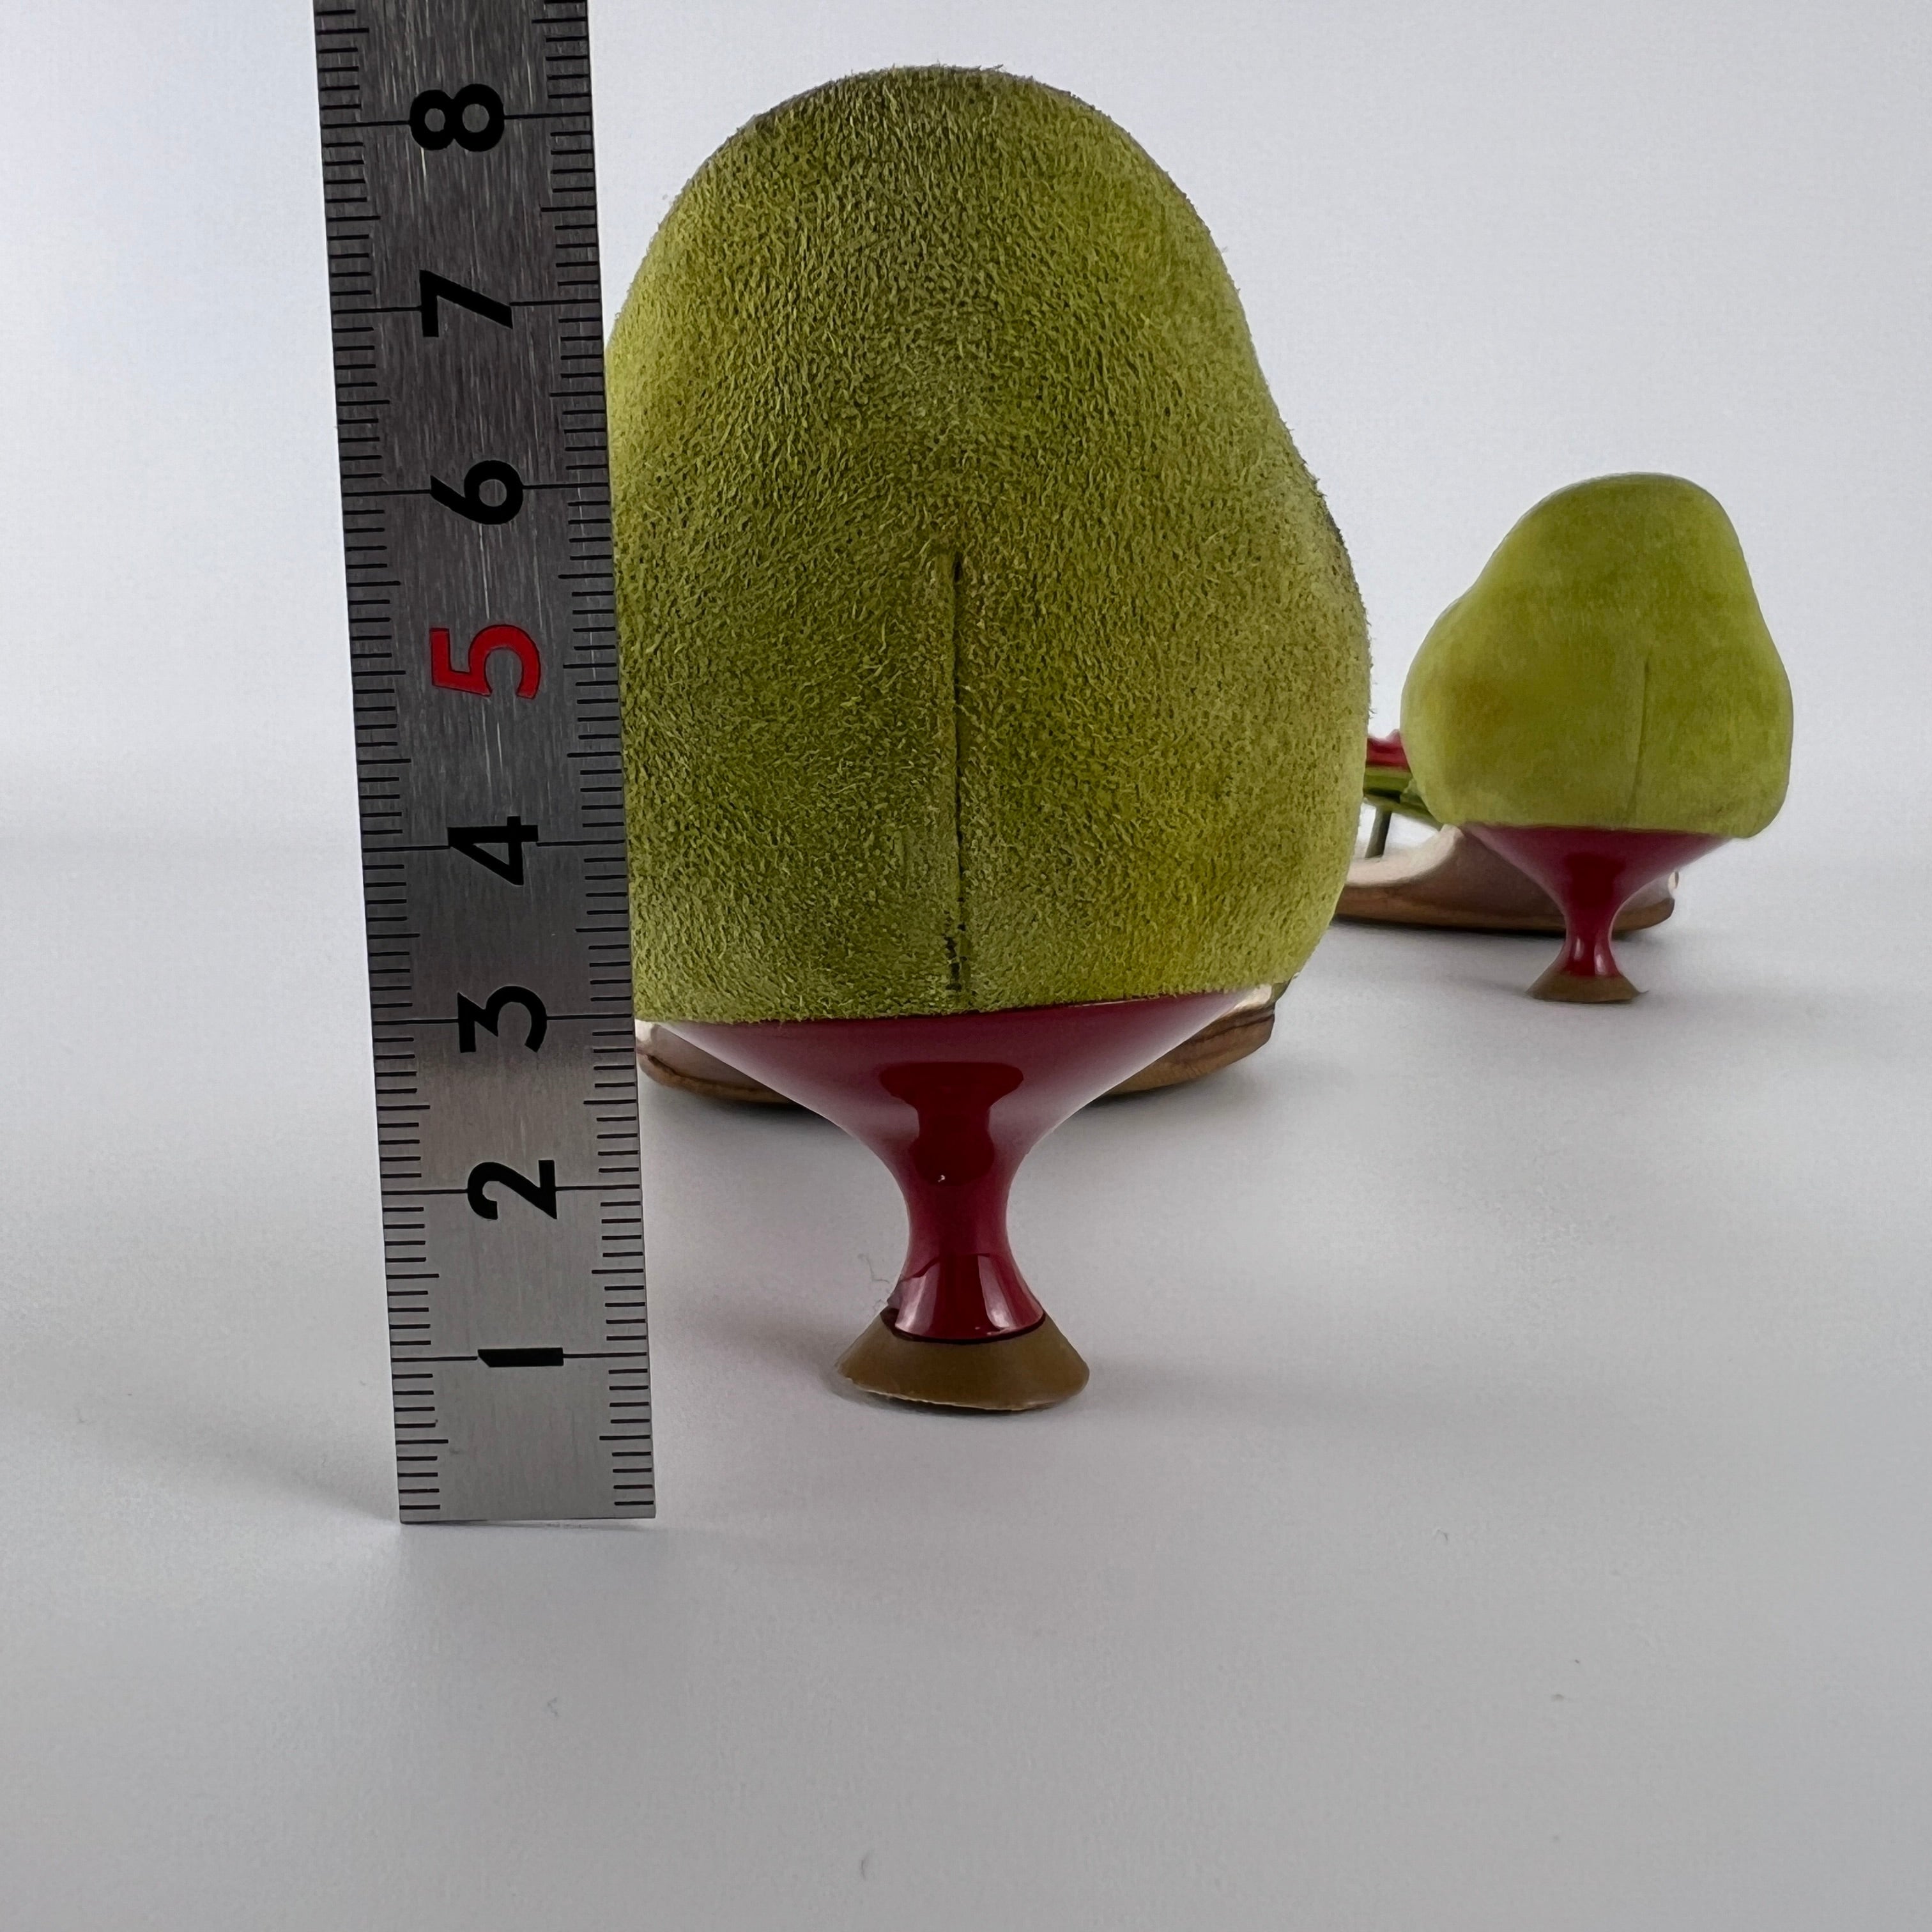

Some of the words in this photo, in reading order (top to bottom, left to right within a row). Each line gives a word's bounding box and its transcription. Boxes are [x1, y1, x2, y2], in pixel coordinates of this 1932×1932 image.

[410, 84, 505, 151] 8
[419, 270, 513, 337] 7
[430, 459, 524, 525] 6
[430, 624, 541, 699] 5
[447, 816, 539, 886] 4
[457, 985, 548, 1053] 3
[467, 1160, 558, 1220] 2
[478, 1347, 564, 1367] 1
